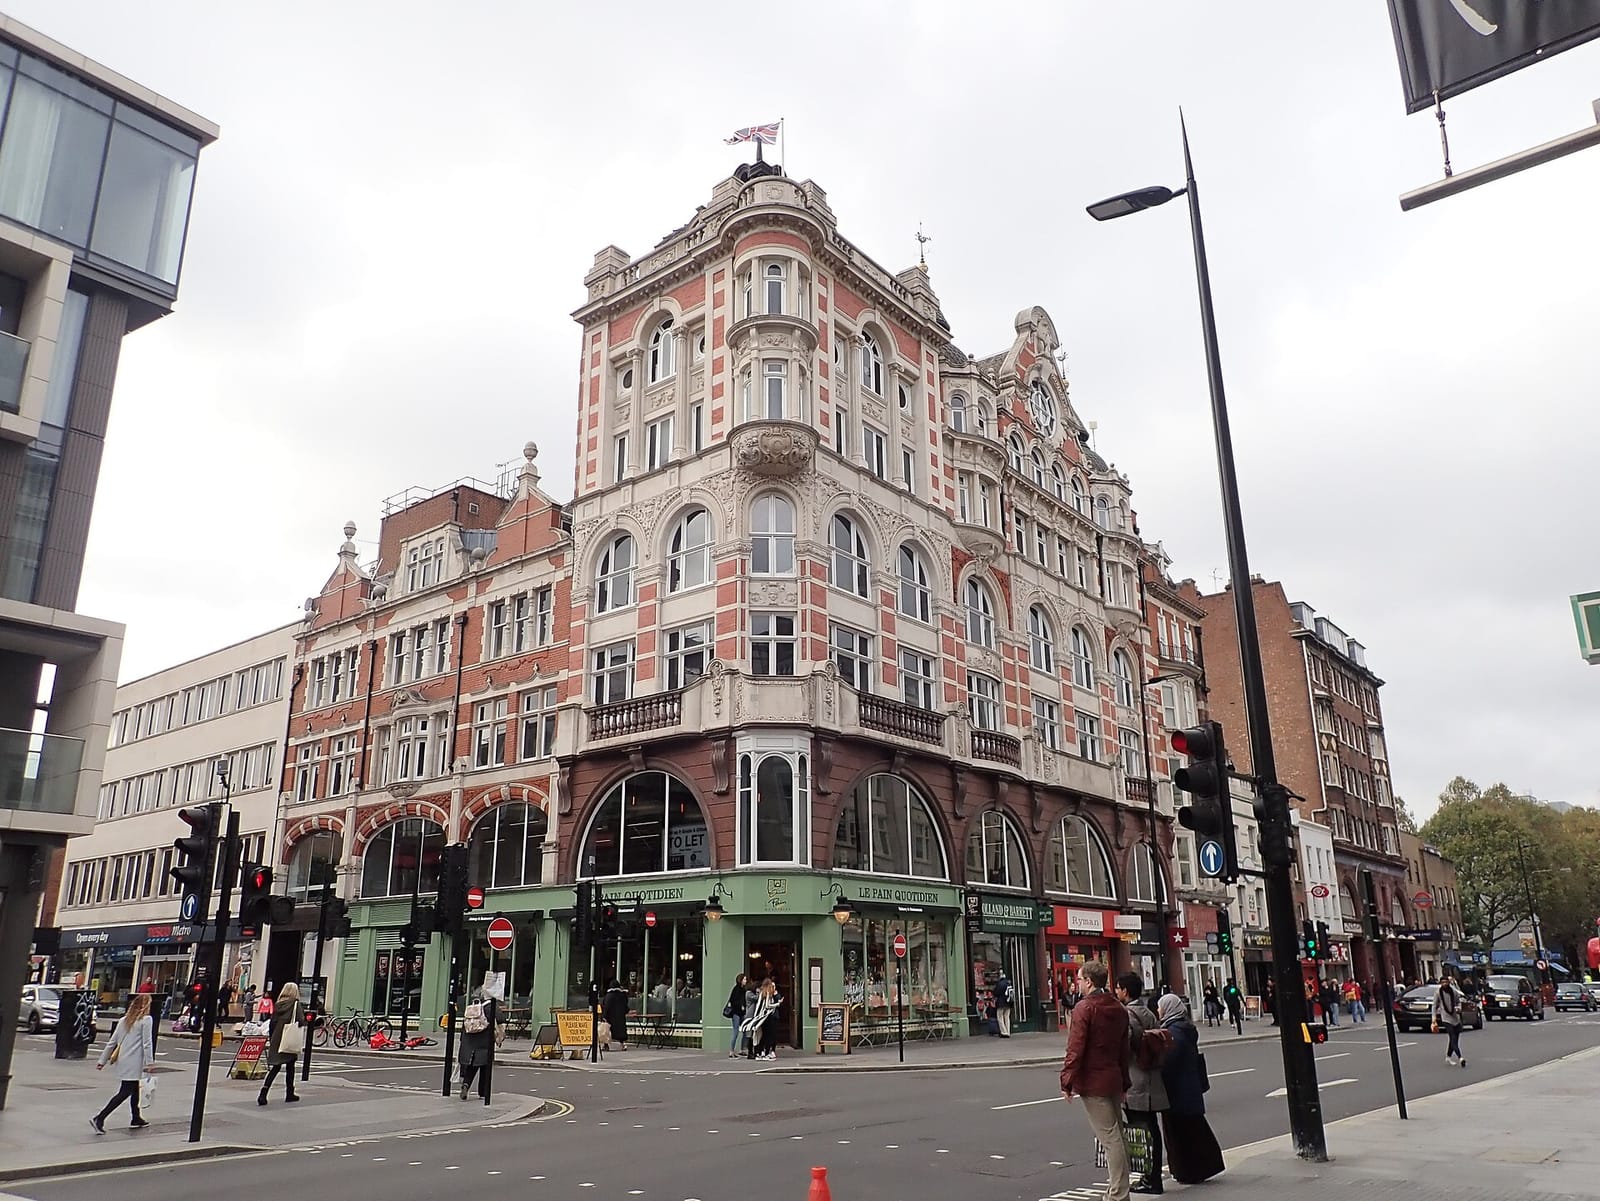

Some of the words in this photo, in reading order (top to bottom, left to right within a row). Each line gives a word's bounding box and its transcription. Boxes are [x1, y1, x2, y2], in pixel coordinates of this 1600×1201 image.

[669, 836, 682, 849] TO
[684, 833, 705, 847] LET
[624, 887, 684, 902] QUOTIDIEN
[859, 888, 870, 898] LE
[872, 888, 892, 899] PAIN
[894, 890, 939, 903] QUOTIDIEN
[981, 902, 1003, 915] OLLAND
[1009, 905, 1033, 919] BARRETT
[1072, 916, 1100, 927] Ryman
[76, 932, 88, 943] Open
[88, 934, 100, 943] every
[100, 931, 109, 942] day
[171, 925, 191, 936] Metro
[243, 1044, 260, 1052] LOOK
